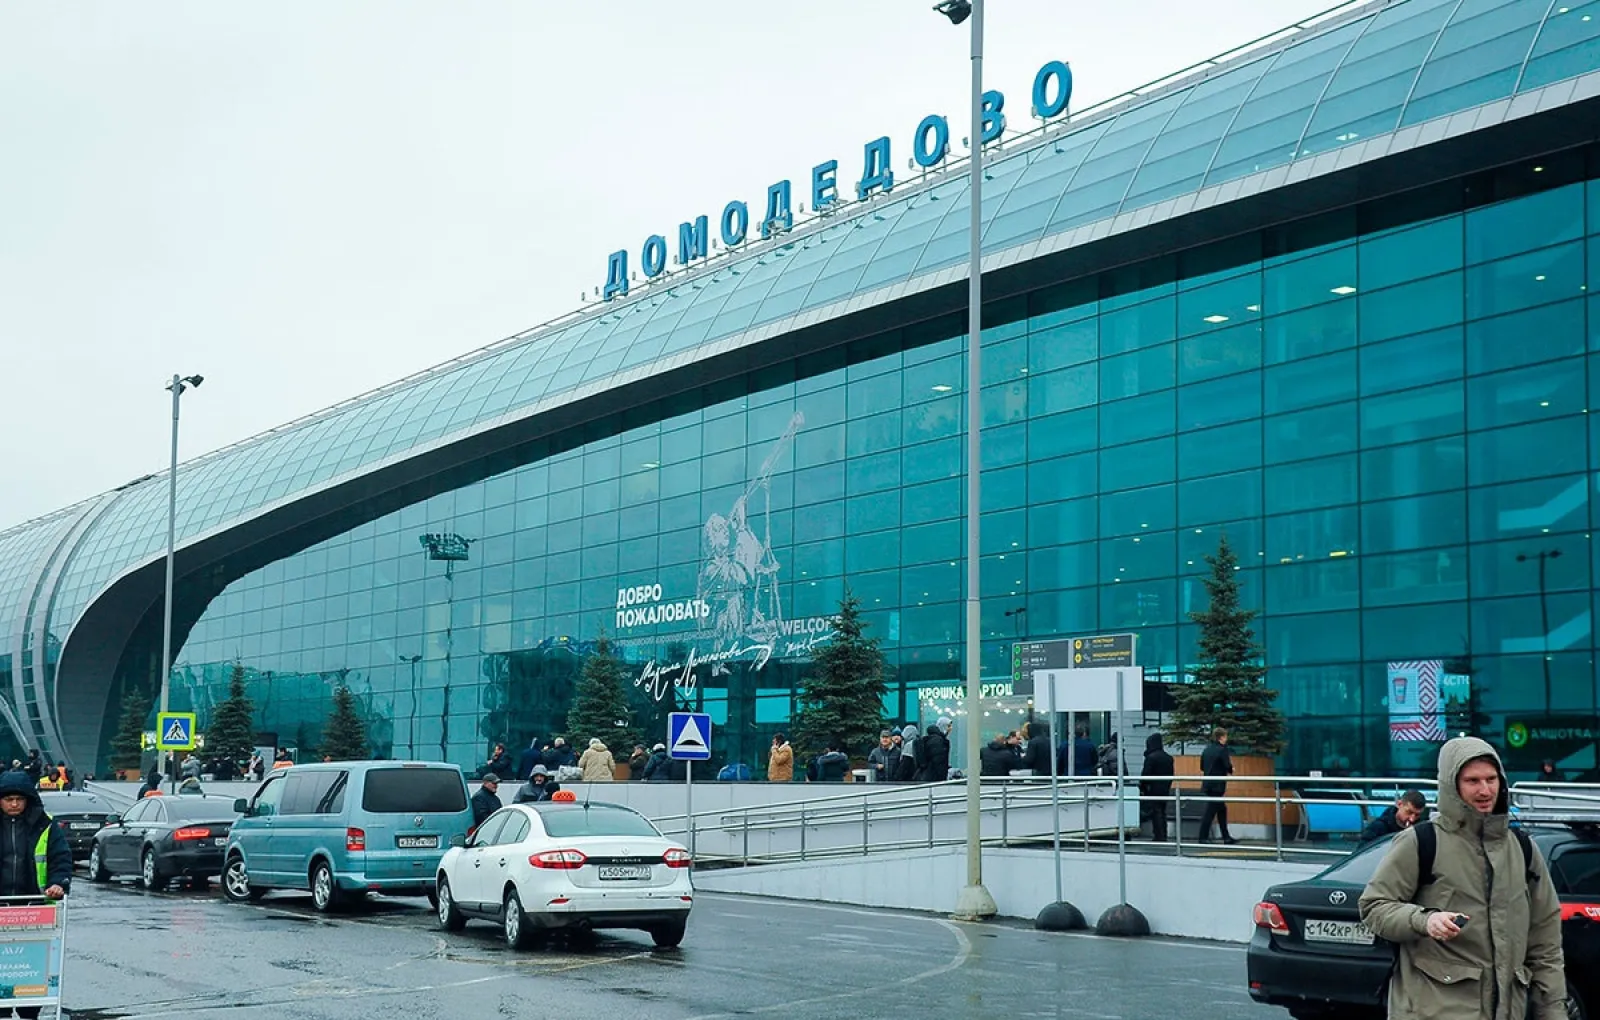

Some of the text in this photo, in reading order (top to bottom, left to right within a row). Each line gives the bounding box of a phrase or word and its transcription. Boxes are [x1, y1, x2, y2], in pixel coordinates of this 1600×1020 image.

[602, 60, 1073, 302] ДОМОДЕДОВО
[616, 583, 662, 608] ДОБРО
[615, 599, 710, 628] ПОЖАЛОВАТЬ
[918, 685, 964, 700] КРОШКА
